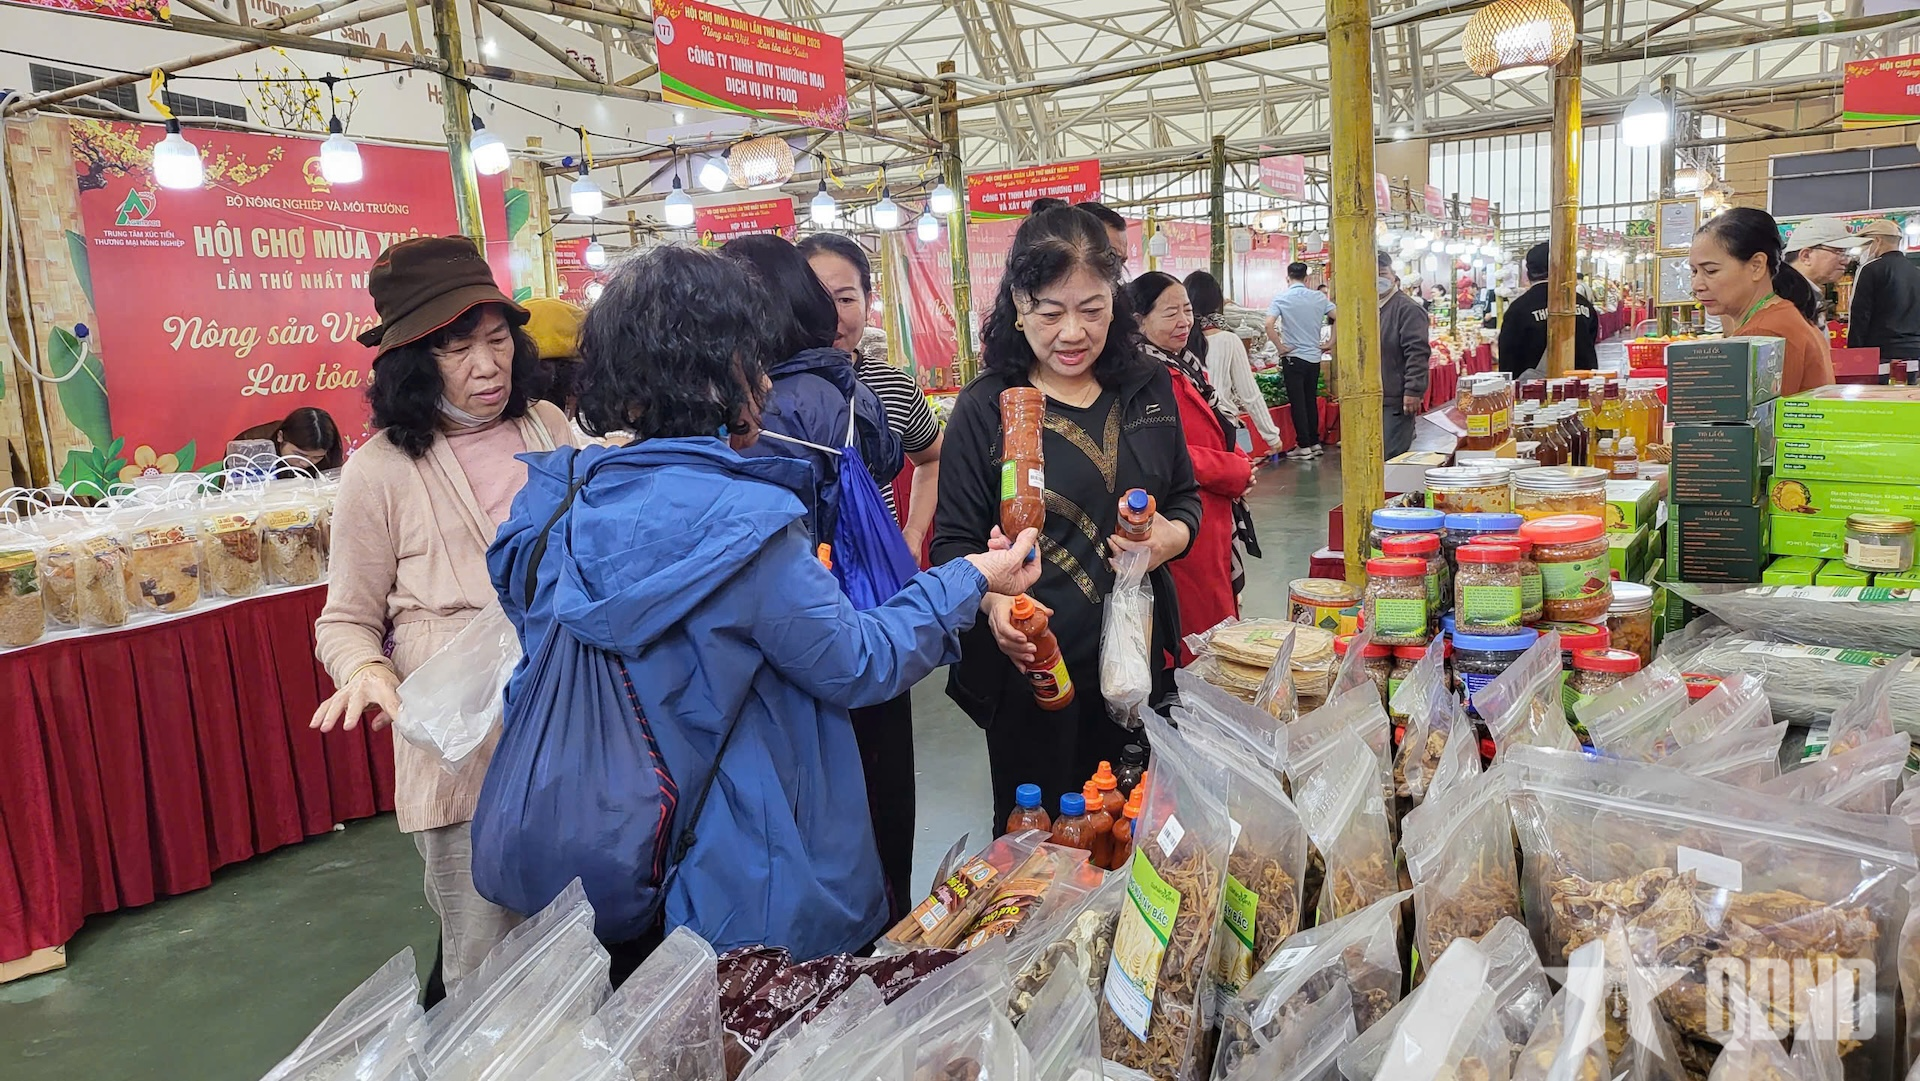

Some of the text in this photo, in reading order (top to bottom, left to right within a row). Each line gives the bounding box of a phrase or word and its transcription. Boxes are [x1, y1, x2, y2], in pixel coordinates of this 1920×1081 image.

[657, 24, 671, 37] 177
[684, 5, 698, 21] HỘI
[698, 9, 713, 25] CHỢ
[714, 12, 729, 27] MÙA
[776, 28, 791, 42] NHẤT
[701, 24, 722, 42] Nông
[757, 39, 770, 50] Lan
[687, 45, 825, 91] CÔNG TY TNHH MTV THƯƠNG MẠI
[1880, 61, 1894, 72] HỘI
[725, 76, 798, 104] DỊCH VỤ NY FOOD
[982, 194, 999, 203] CÔNG
[999, 192, 1007, 201] TY
[1007, 190, 1024, 200] TNHH
[1047, 185, 1073, 195] THƯƠNG
[1073, 183, 1086, 193] MẠI
[226, 195, 409, 215] BỘ NÔNG NGHIỆP VÀ MÔI TRƯỜNG
[94, 238, 185, 248] THƯƠNG MẠI NÔNG NGHIỆP
[103, 230, 175, 239] TRUNG TÂM XÚC TIẾN
[193, 220, 244, 264] HỘI
[251, 226, 306, 264] CHỢ
[312, 226, 372, 259] MÙA
[216, 267, 371, 290] LẦN THỨ NHẤT NĂ
[162, 316, 261, 359] Nông
[266, 317, 319, 345] sản
[240, 362, 310, 397] Lan
[315, 363, 362, 391] tỏa
[1150, 906, 1169, 927] BẮC
[1232, 910, 1249, 930] BẮC
